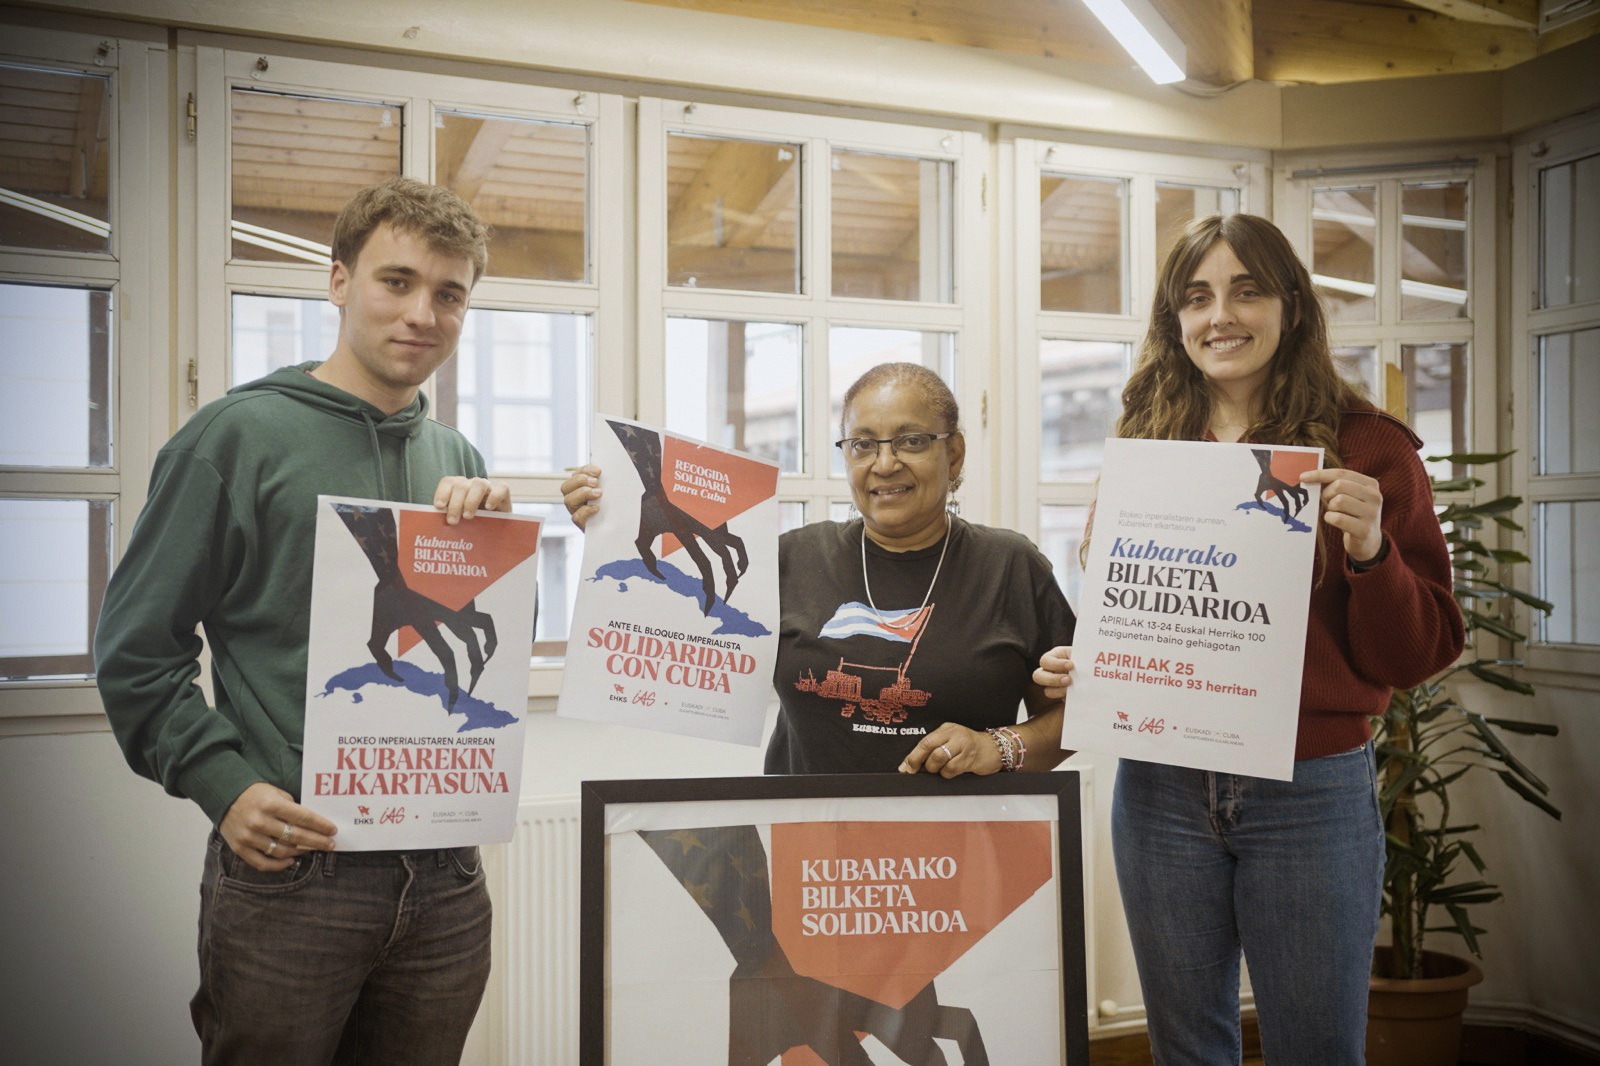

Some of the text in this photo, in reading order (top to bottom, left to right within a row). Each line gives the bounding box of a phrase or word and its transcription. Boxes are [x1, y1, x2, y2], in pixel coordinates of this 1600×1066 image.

[674, 470, 732, 495] SOLIDARIA
[676, 459, 730, 484] RECOGIDA
[672, 484, 726, 504] para Cuba
[1118, 520, 1196, 532] Kubarekin elkartasuna
[1119, 510, 1142, 519] Blokeo
[414, 535, 473, 550] Kubarako
[1110, 537, 1237, 568] Kubarako
[414, 548, 466, 563] BILKETA
[413, 561, 488, 577] SOLIDARIOA
[1107, 562, 1219, 592] BILKETA
[1103, 586, 1271, 625] SOLIDARIOA
[608, 620, 741, 651] ANTE EL BLOQUEO IMPERIALISTA
[1098, 628, 1240, 652] hezigunetan baino gehiagotan
[1100, 616, 1266, 642] APIRILAK 13-24 Euskal Herriko 100
[587, 627, 756, 675] SOLIDARIDAD
[606, 654, 731, 694] CON CUBA
[1094, 651, 1194, 676] APIRILAK 25
[1093, 666, 1257, 697] Euskal Herriko 93 herritan
[609, 694, 627, 703] EHKS
[681, 702, 704, 710] EUSKADI
[852, 724, 927, 735] EUSKADI CUBA
[1113, 722, 1132, 732] EHKS
[1185, 727, 1212, 735] EUSKADI
[338, 736, 376, 745] BLOKEO
[378, 736, 454, 745] INPERIALISTAREN
[336, 747, 495, 770] KUBAREKIN
[314, 772, 509, 796] ELKARTASUNA
[802, 856, 957, 882] KUBARAKO
[802, 884, 917, 909] BILKETA
[802, 910, 968, 936] SOLIDARIOA
